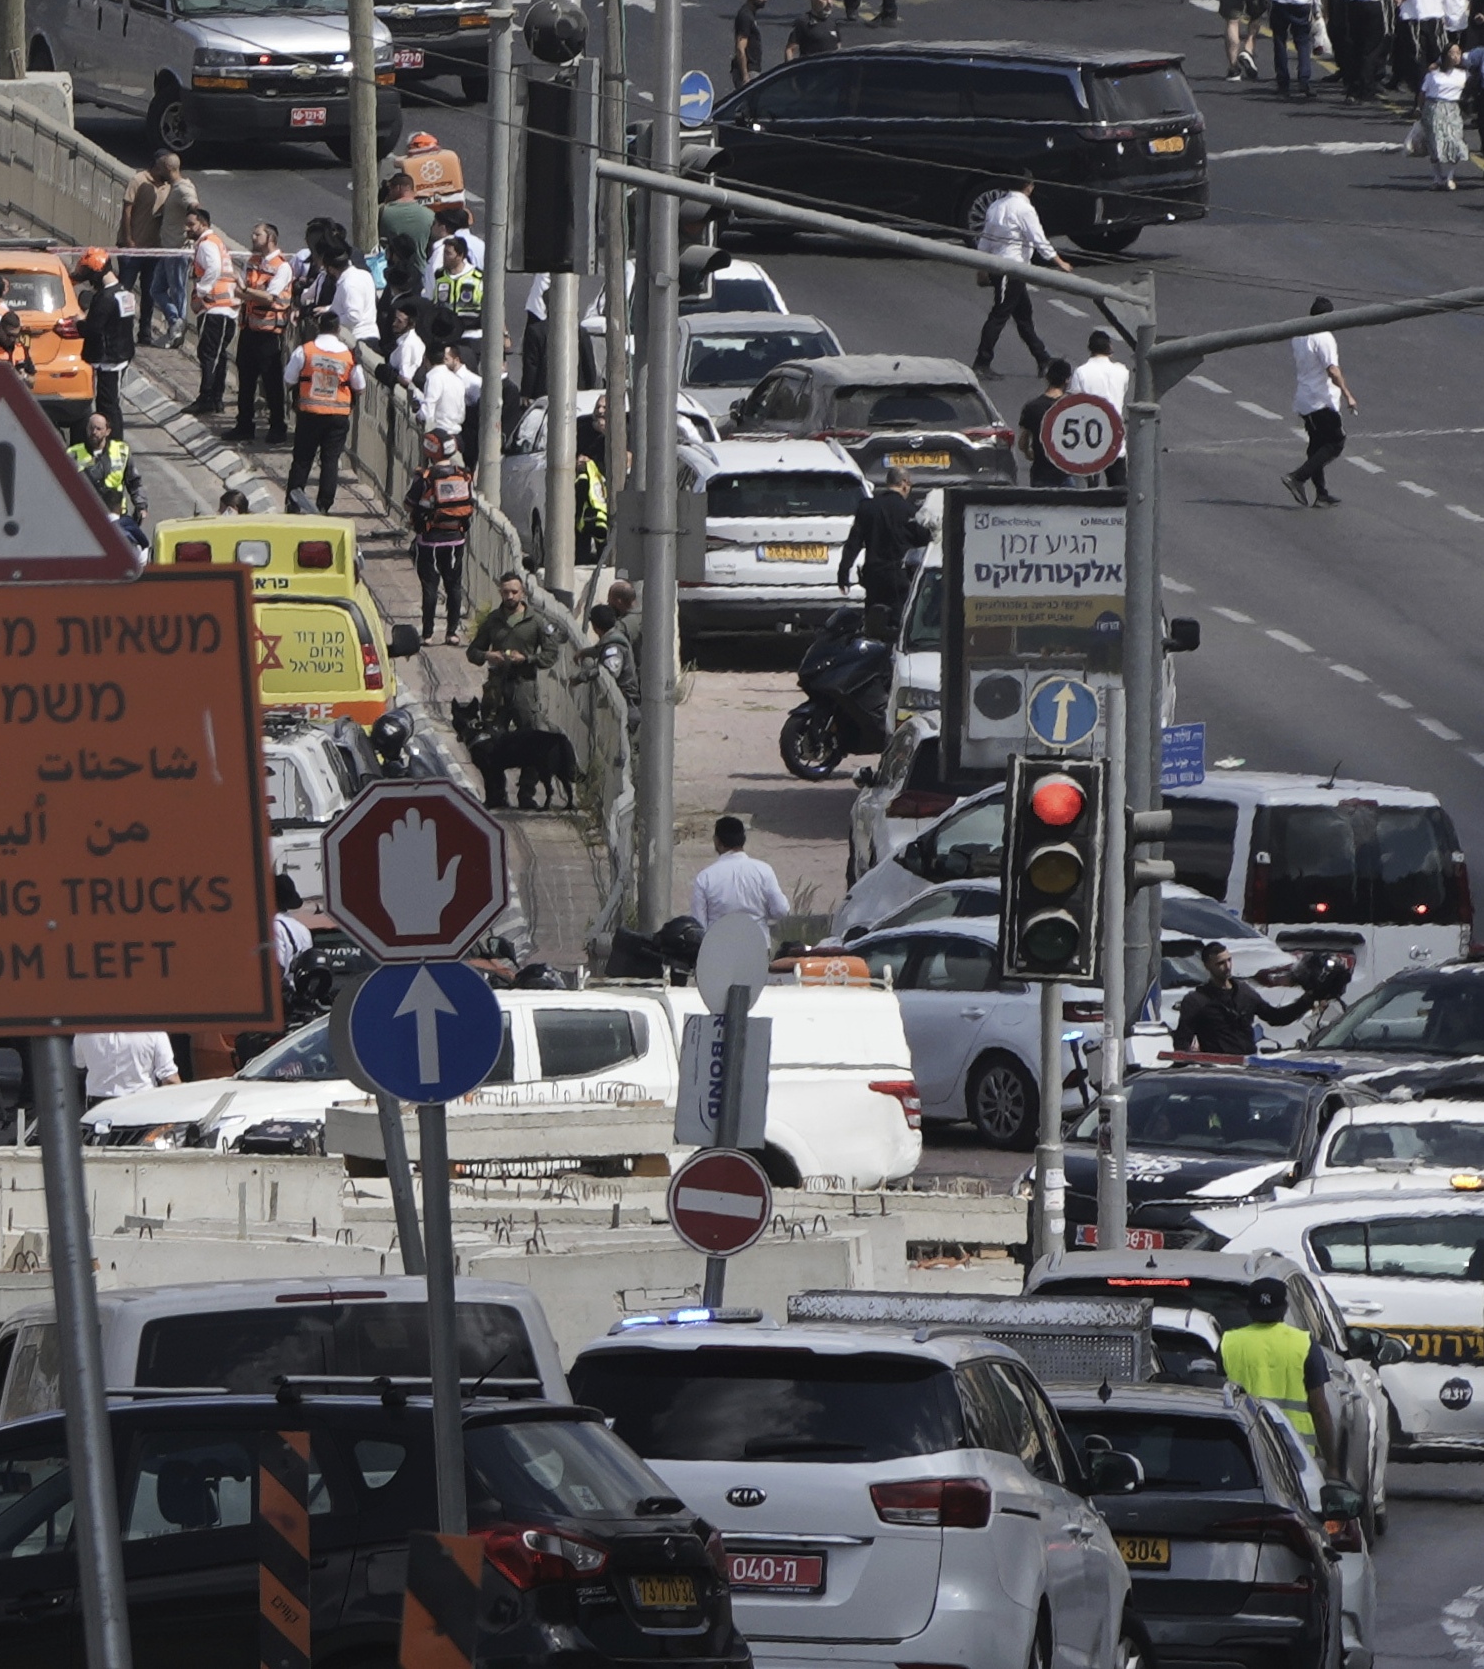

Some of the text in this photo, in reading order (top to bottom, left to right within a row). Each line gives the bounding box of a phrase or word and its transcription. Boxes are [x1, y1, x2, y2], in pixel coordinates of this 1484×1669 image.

[1062, 418, 1104, 449] 50
[1000, 533, 1098, 559] הגיע זמן
[974, 559, 1123, 589] אלקטרולוקס
[56, 611, 222, 657] משאיות
[294, 631, 345, 644] מגן דוד
[289, 658, 344, 673] בישראל
[309, 647, 344, 658] אדום
[36, 747, 198, 784] شاحنات
[85, 813, 151, 855] من
[61, 876, 233, 916] TRUCKS
[65, 941, 176, 980] LEFT
[708, 1014, 726, 1119] R-BOND
[731, 1491, 759, 1503] KIA
